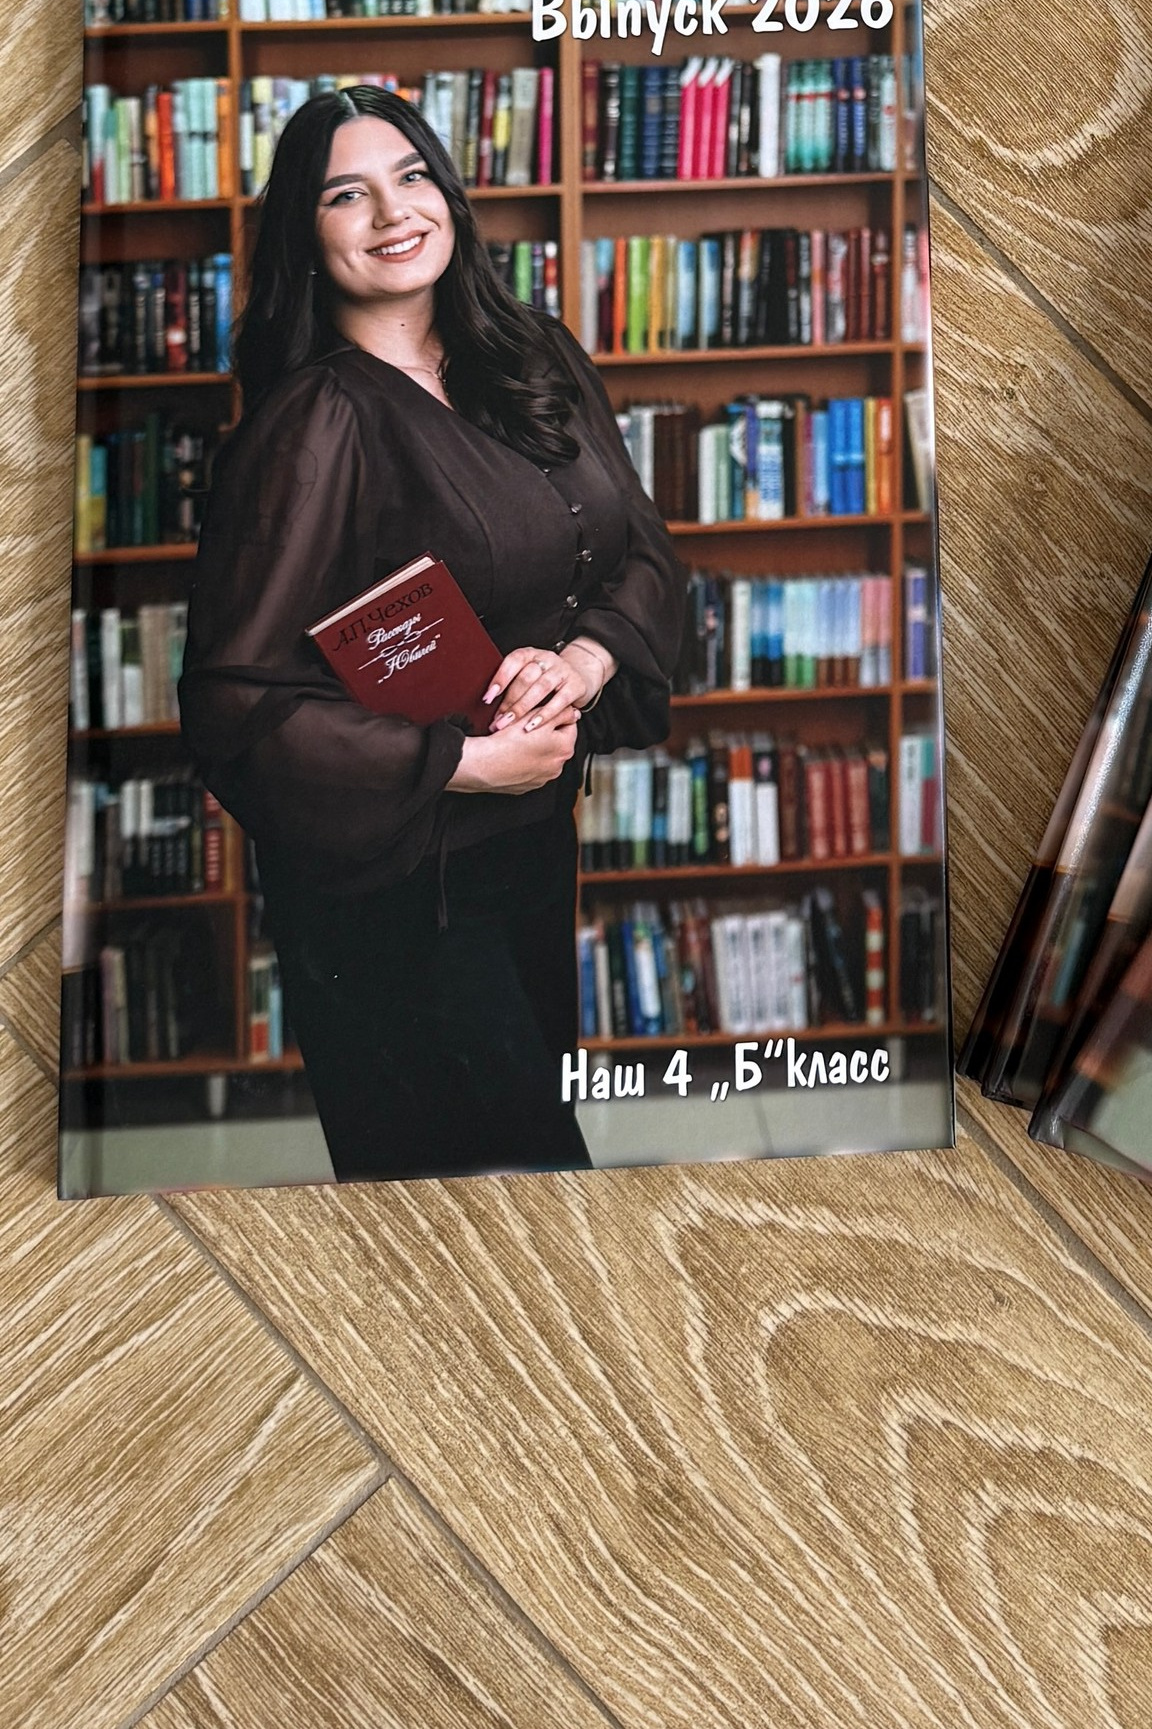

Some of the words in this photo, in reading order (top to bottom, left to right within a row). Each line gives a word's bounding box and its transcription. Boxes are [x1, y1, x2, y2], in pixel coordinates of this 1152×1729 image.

[366, 612, 423, 650] Рассказы
[561, 1048, 645, 1102] Наш
[662, 1049, 692, 1097] 4
